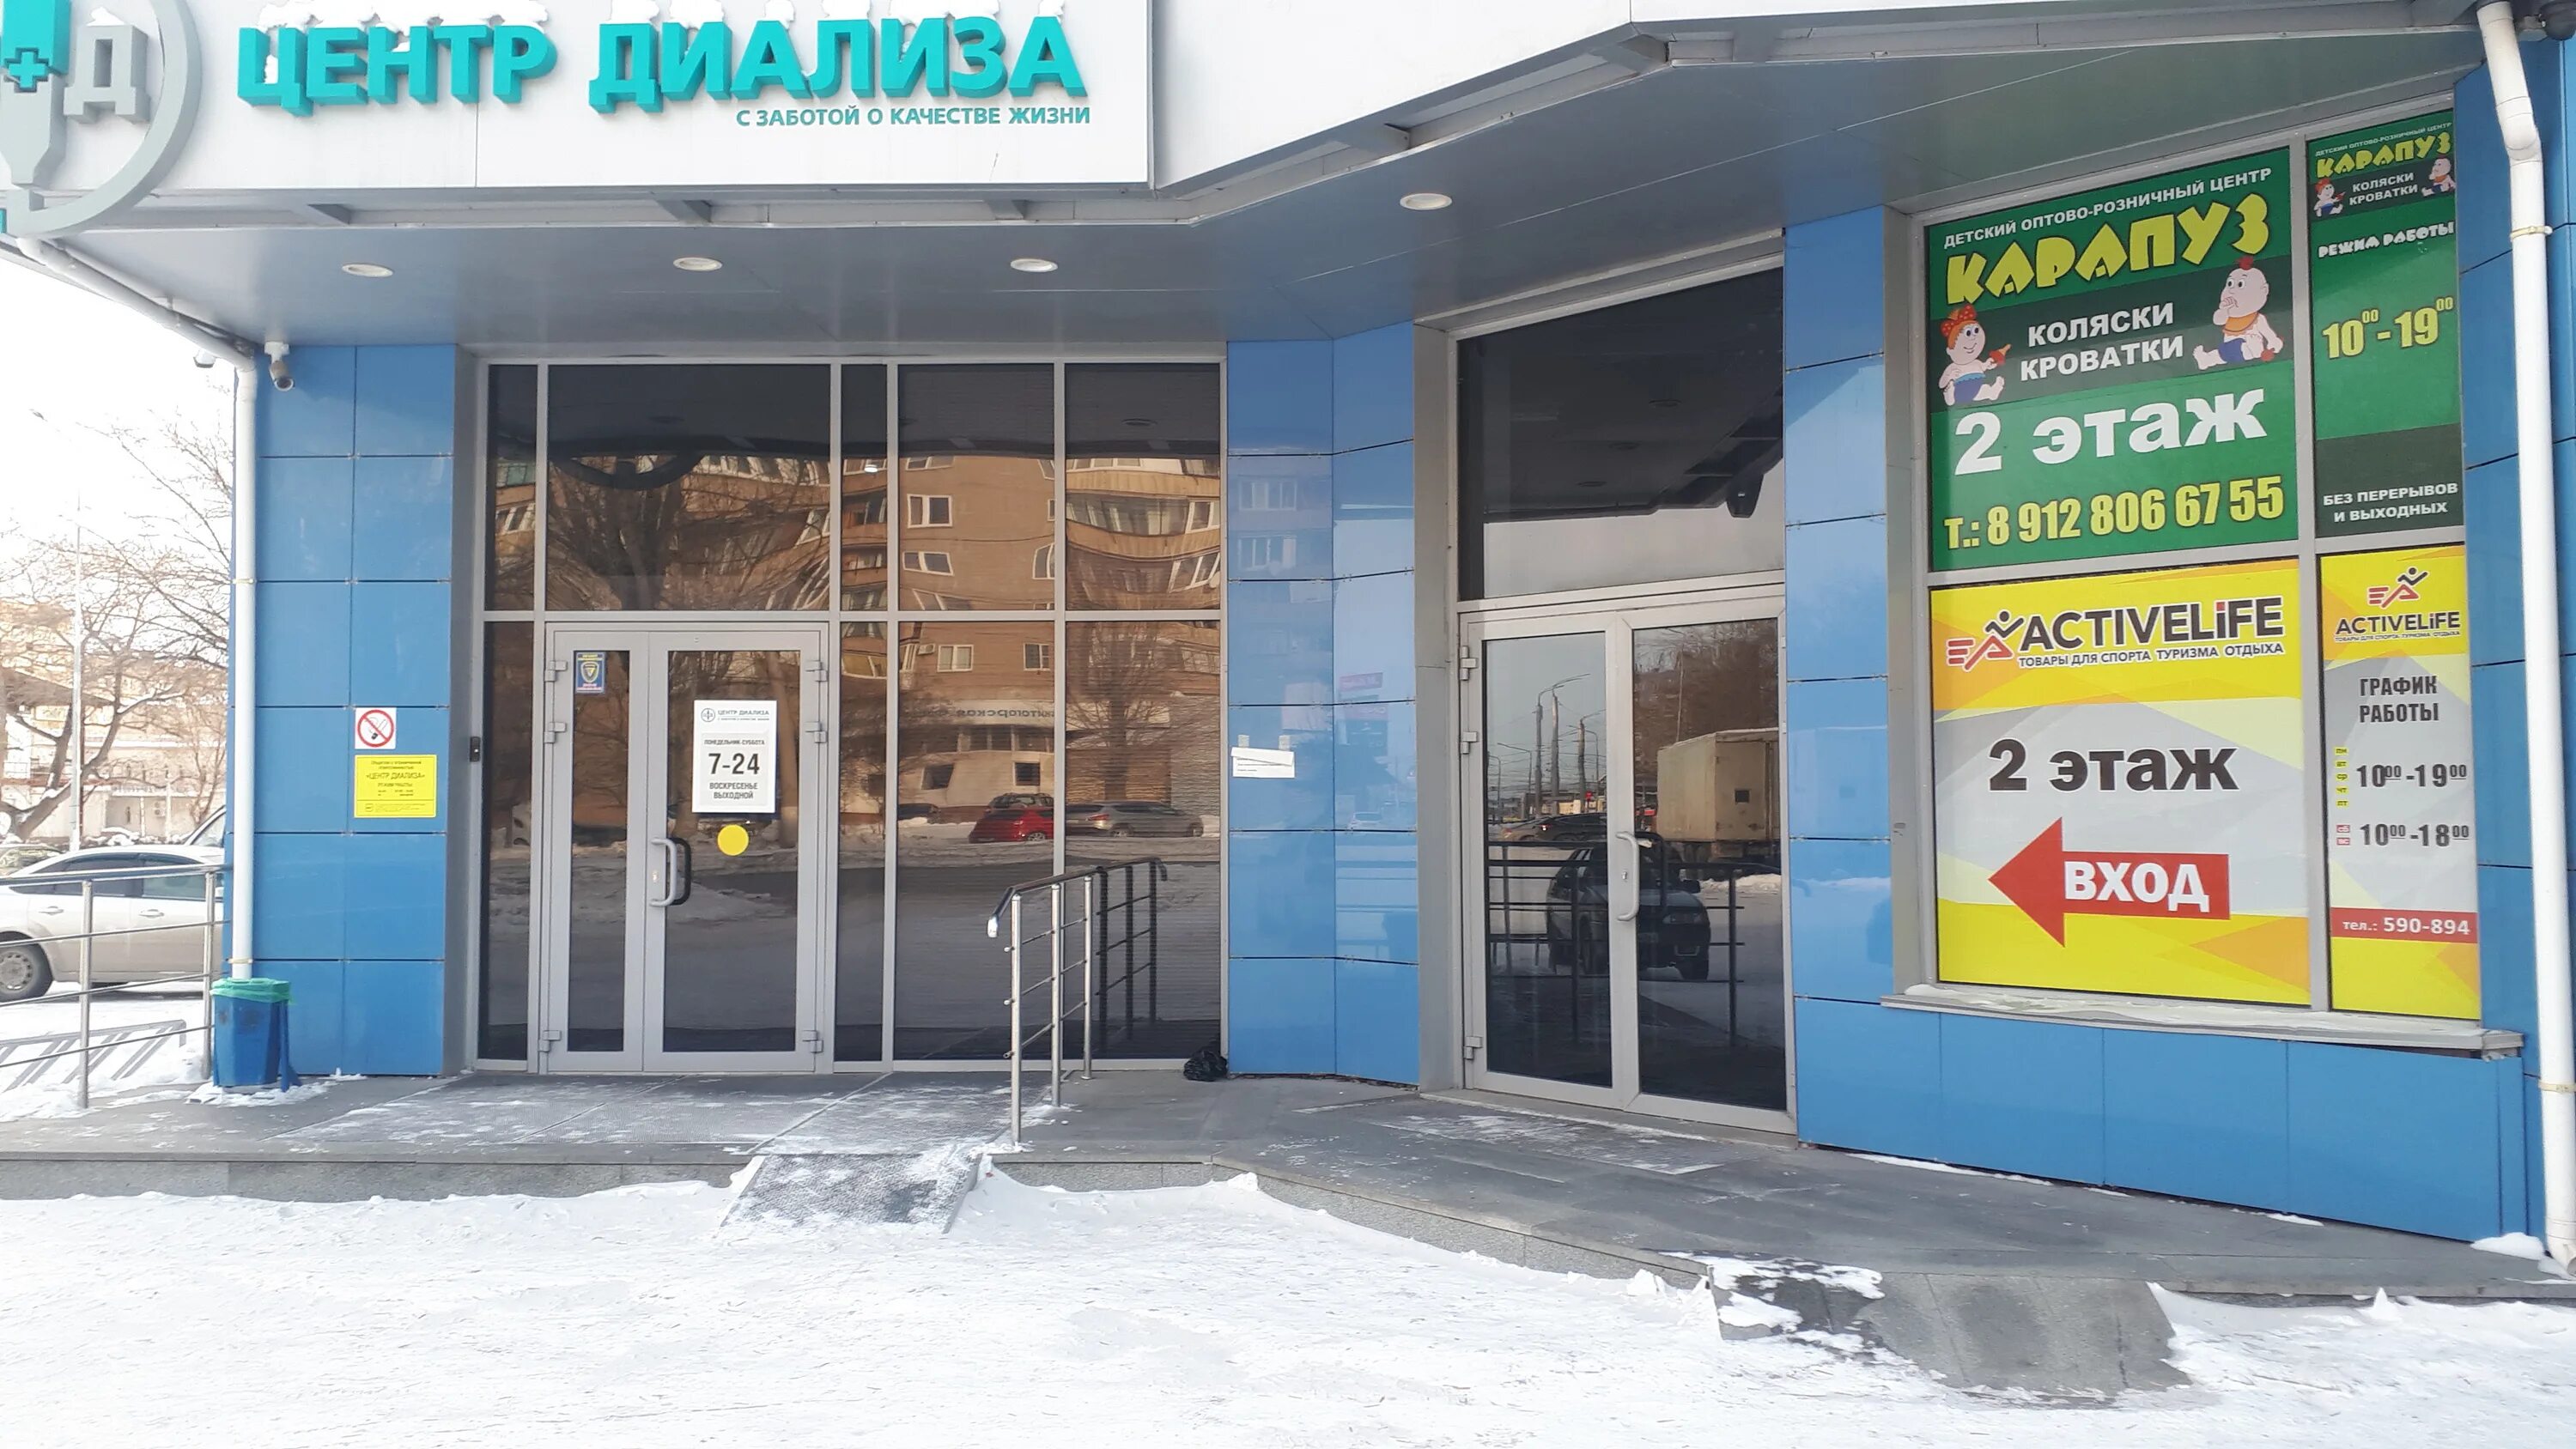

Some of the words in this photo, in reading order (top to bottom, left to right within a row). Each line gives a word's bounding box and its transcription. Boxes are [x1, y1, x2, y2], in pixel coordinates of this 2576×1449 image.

[238, 25, 558, 117] ЦЕНТР
[589, 16, 1088, 113] ДИАЛИЗА
[736, 110, 750, 126] С
[756, 105, 860, 126] ЗАБОТОЙ
[867, 109, 884, 125] О
[890, 106, 1001, 125] КАЧЕСТВЕ
[1008, 106, 1091, 124] ЖИЗНИ
[2317, 131, 2451, 179] КАРАПУЗ
[2349, 184, 2418, 206] КРОВАТКИ
[2353, 172, 2415, 193] КОЛЯСКИ
[1944, 219, 2016, 249] ДЕТСКИЙ
[2020, 179, 2204, 230] ОПТОВО-РОЗНИЧНЫЙ
[2209, 167, 2272, 192] ЦЕНТР
[1946, 192, 2269, 305] КАРАПУЗ
[2318, 236, 2380, 258] РЕЖИМ
[2383, 221, 2455, 246] РАБОТЫ
[2027, 301, 2174, 348] КОЛЯСКИ
[2020, 335, 2184, 381] КРОВАТКИ
[1954, 411, 2002, 476] 2
[2032, 388, 2268, 464] этаж
[2323, 493, 2354, 506] БЕЗ
[2357, 482, 2458, 503] ПЕРЕРЫВОВ
[1987, 505, 2011, 545] 8
[2018, 498, 2081, 543] 912
[2090, 488, 2166, 535] 806
[2174, 482, 2221, 526] 67
[2229, 475, 2284, 522] 55
[2334, 512, 2345, 523] И
[2349, 501, 2448, 521] ВЫХОДНЫХ
[2020, 654, 2069, 668] ТОВАРЫ
[2072, 653, 2098, 667] ДЛЯ
[2100, 651, 2150, 664] СПОРТА
[2157, 647, 2218, 661] ТУРИЗМА
[2225, 644, 2284, 658] ОТДЫХА
[2360, 676, 2438, 697] ГРАФИК
[2360, 703, 2439, 724] РАБОТЫ
[708, 753, 759, 774] 7-24
[1989, 738, 2028, 791] 2
[2049, 748, 2239, 792] этаж
[714, 791, 753, 799] ВЫХОДНОЙ
[2064, 861, 2209, 912] ВХОД
[2342, 921, 2378, 931] тел.:
[2384, 918, 2470, 935] 590-894
